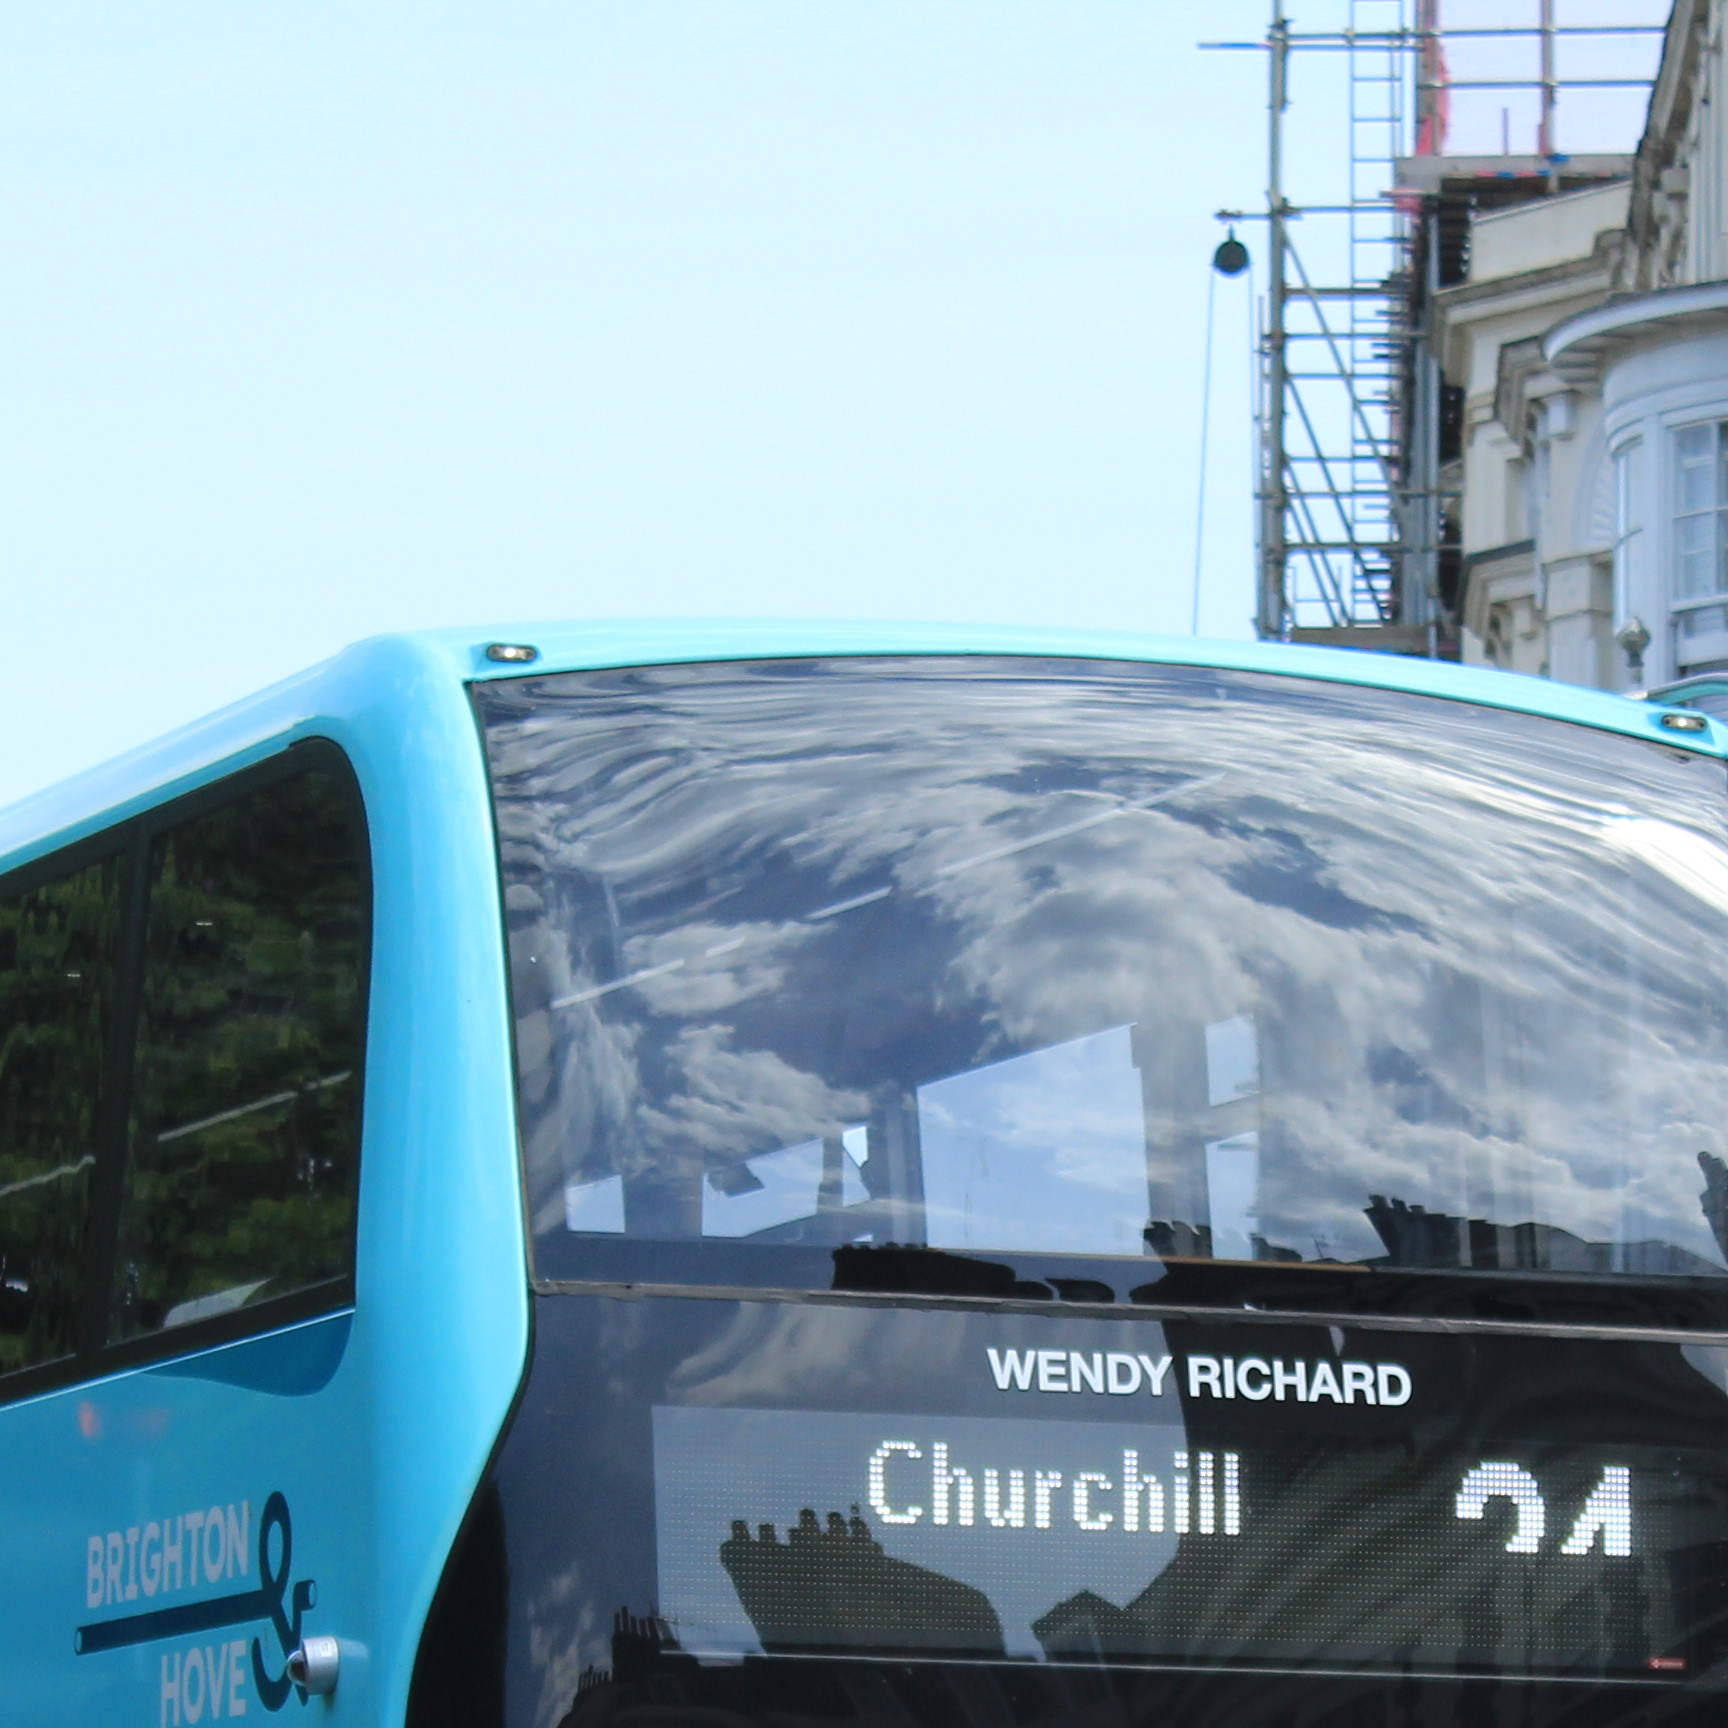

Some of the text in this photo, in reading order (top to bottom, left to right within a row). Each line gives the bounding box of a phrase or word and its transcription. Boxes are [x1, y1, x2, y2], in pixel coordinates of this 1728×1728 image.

[987, 1349, 1413, 1406] WENDY RICHARD
[868, 1440, 1242, 1536] Churchill
[86, 1500, 249, 1609] BRIGHTON
[160, 1640, 246, 1728] HOVE
